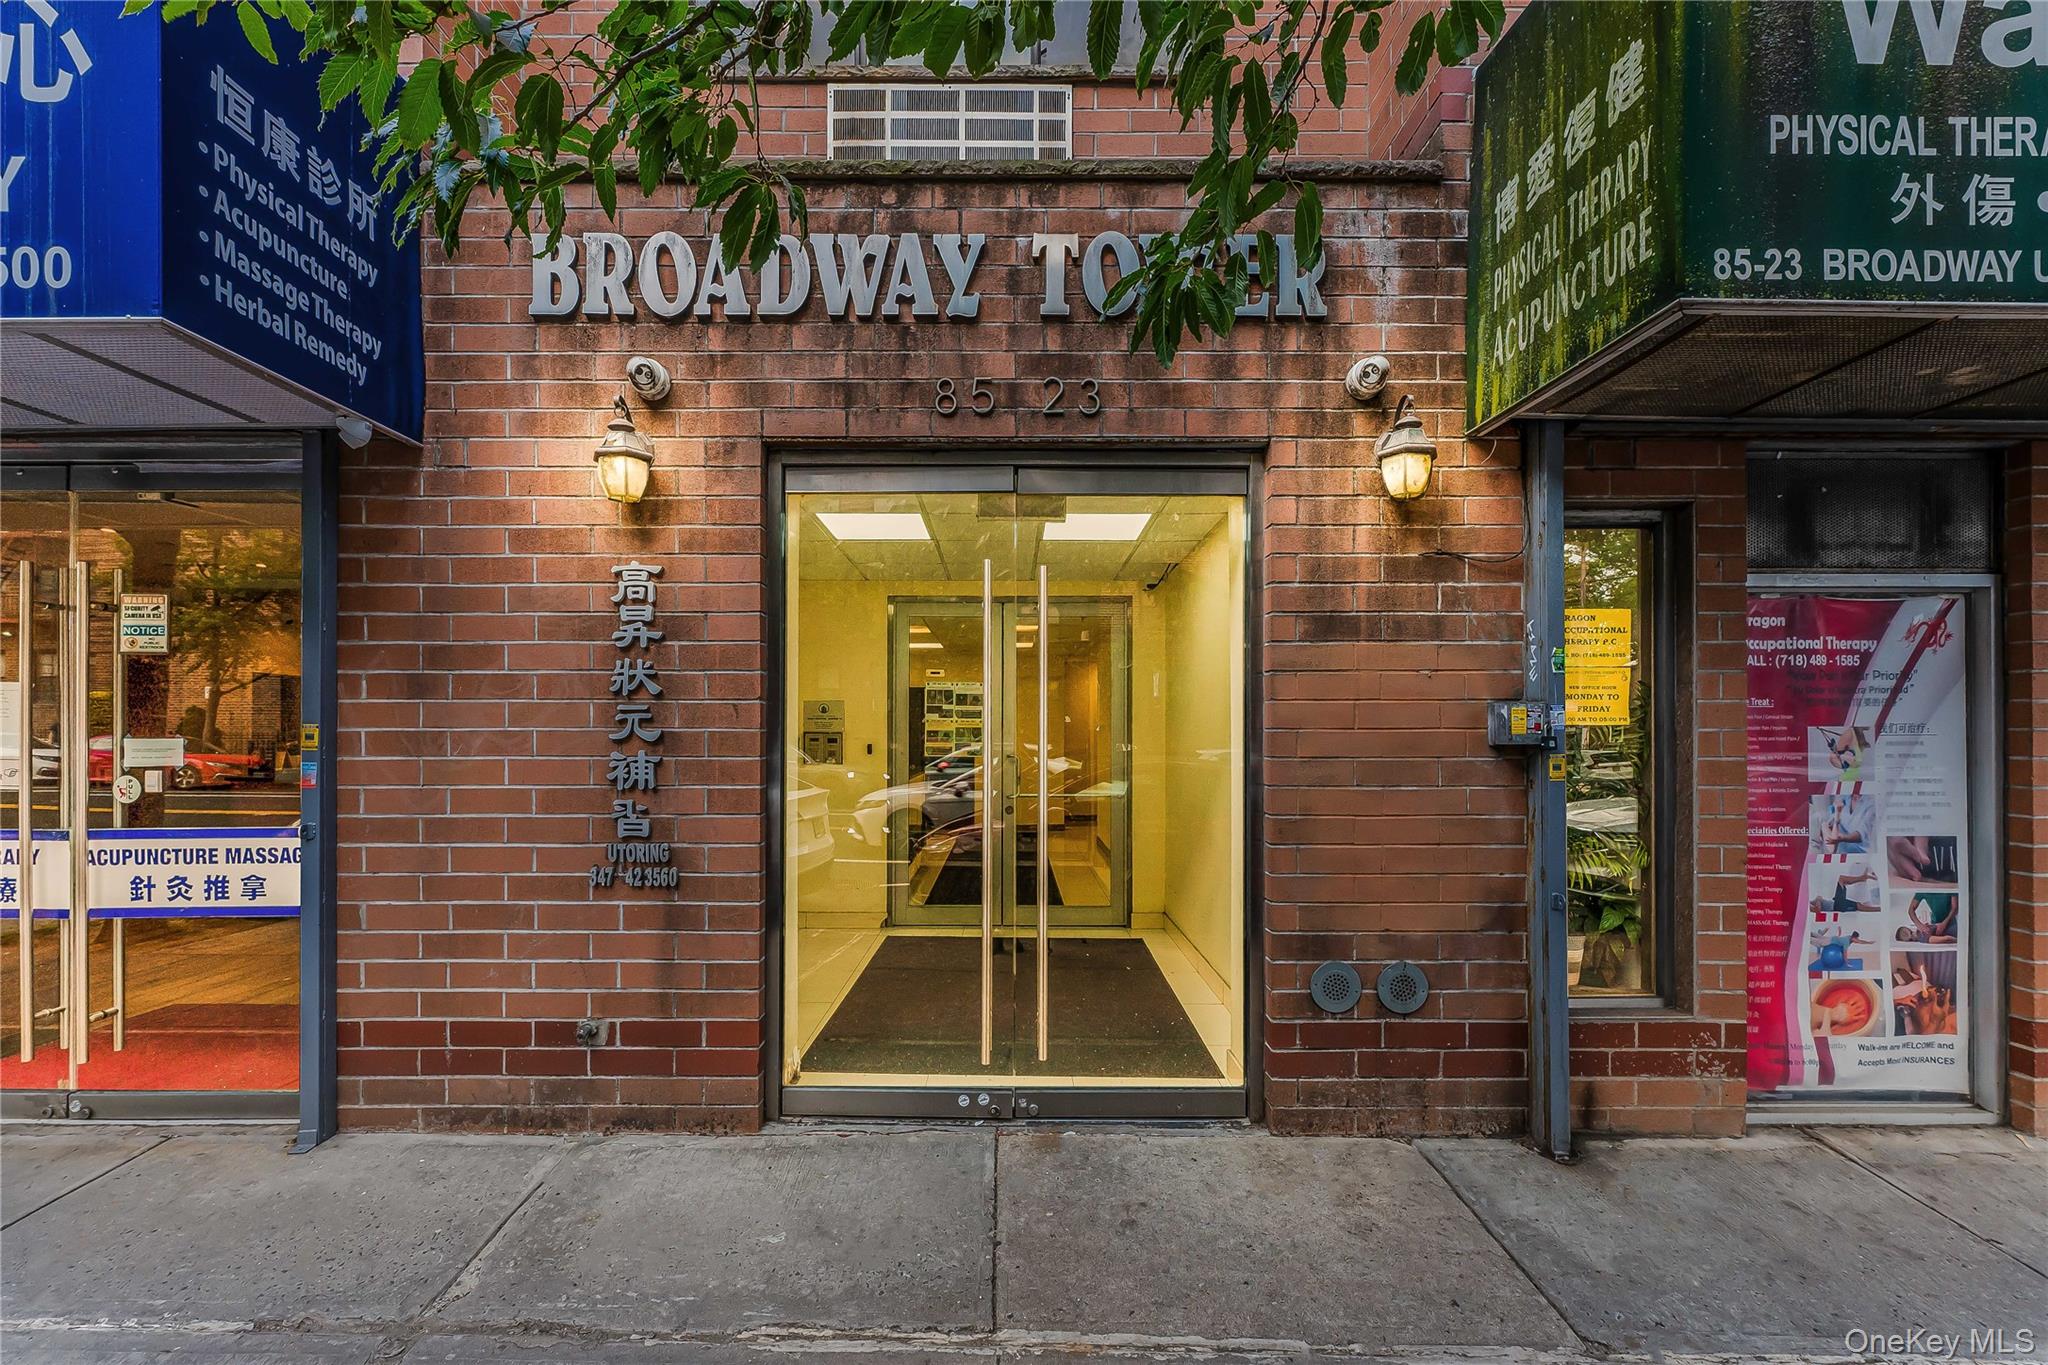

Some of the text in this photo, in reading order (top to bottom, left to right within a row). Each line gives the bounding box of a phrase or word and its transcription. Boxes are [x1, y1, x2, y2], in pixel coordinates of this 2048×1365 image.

[1769, 114, 1937, 156] PHYSICAL
[1890, 172, 2016, 227] 外傷
[214, 143, 379, 288] Physical Therapy
[1493, 124, 1654, 313] PHYSICAL THERAPY
[213, 188, 349, 301] Acupuncture
[528, 230, 1328, 318] BROADWAY TOER
[1713, 248, 1803, 281] 85-23
[1823, 249, 2023, 283] BROADWAY
[214, 230, 383, 360] Massage Therapy
[1492, 205, 1654, 372] ACUPUNCTURE
[214, 273, 368, 387] Herbal Remedy
[935, 376, 1101, 415] 85 23
[123, 596, 165, 604] WARNING
[123, 626, 166, 635] NOTICE
[1746, 636, 1878, 652] ccupational Therapy
[1747, 655, 1767, 666] ALL
[1775, 655, 1808, 669] (718)
[1809, 655, 1828, 667] 489
[1565, 693, 1620, 701] MONDAY TO
[1577, 705, 1611, 713] FRIDAY
[1778, 826, 1809, 834] Offered:
[88, 847, 219, 866] ACUPUNCTURE
[607, 843, 671, 863] UTORING
[130, 874, 267, 902] 針灸推拿
[1901, 1041, 1936, 1050] WELCOME
[1937, 1042, 1955, 1050] and
[1901, 1056, 1956, 1066] INSURANCES
